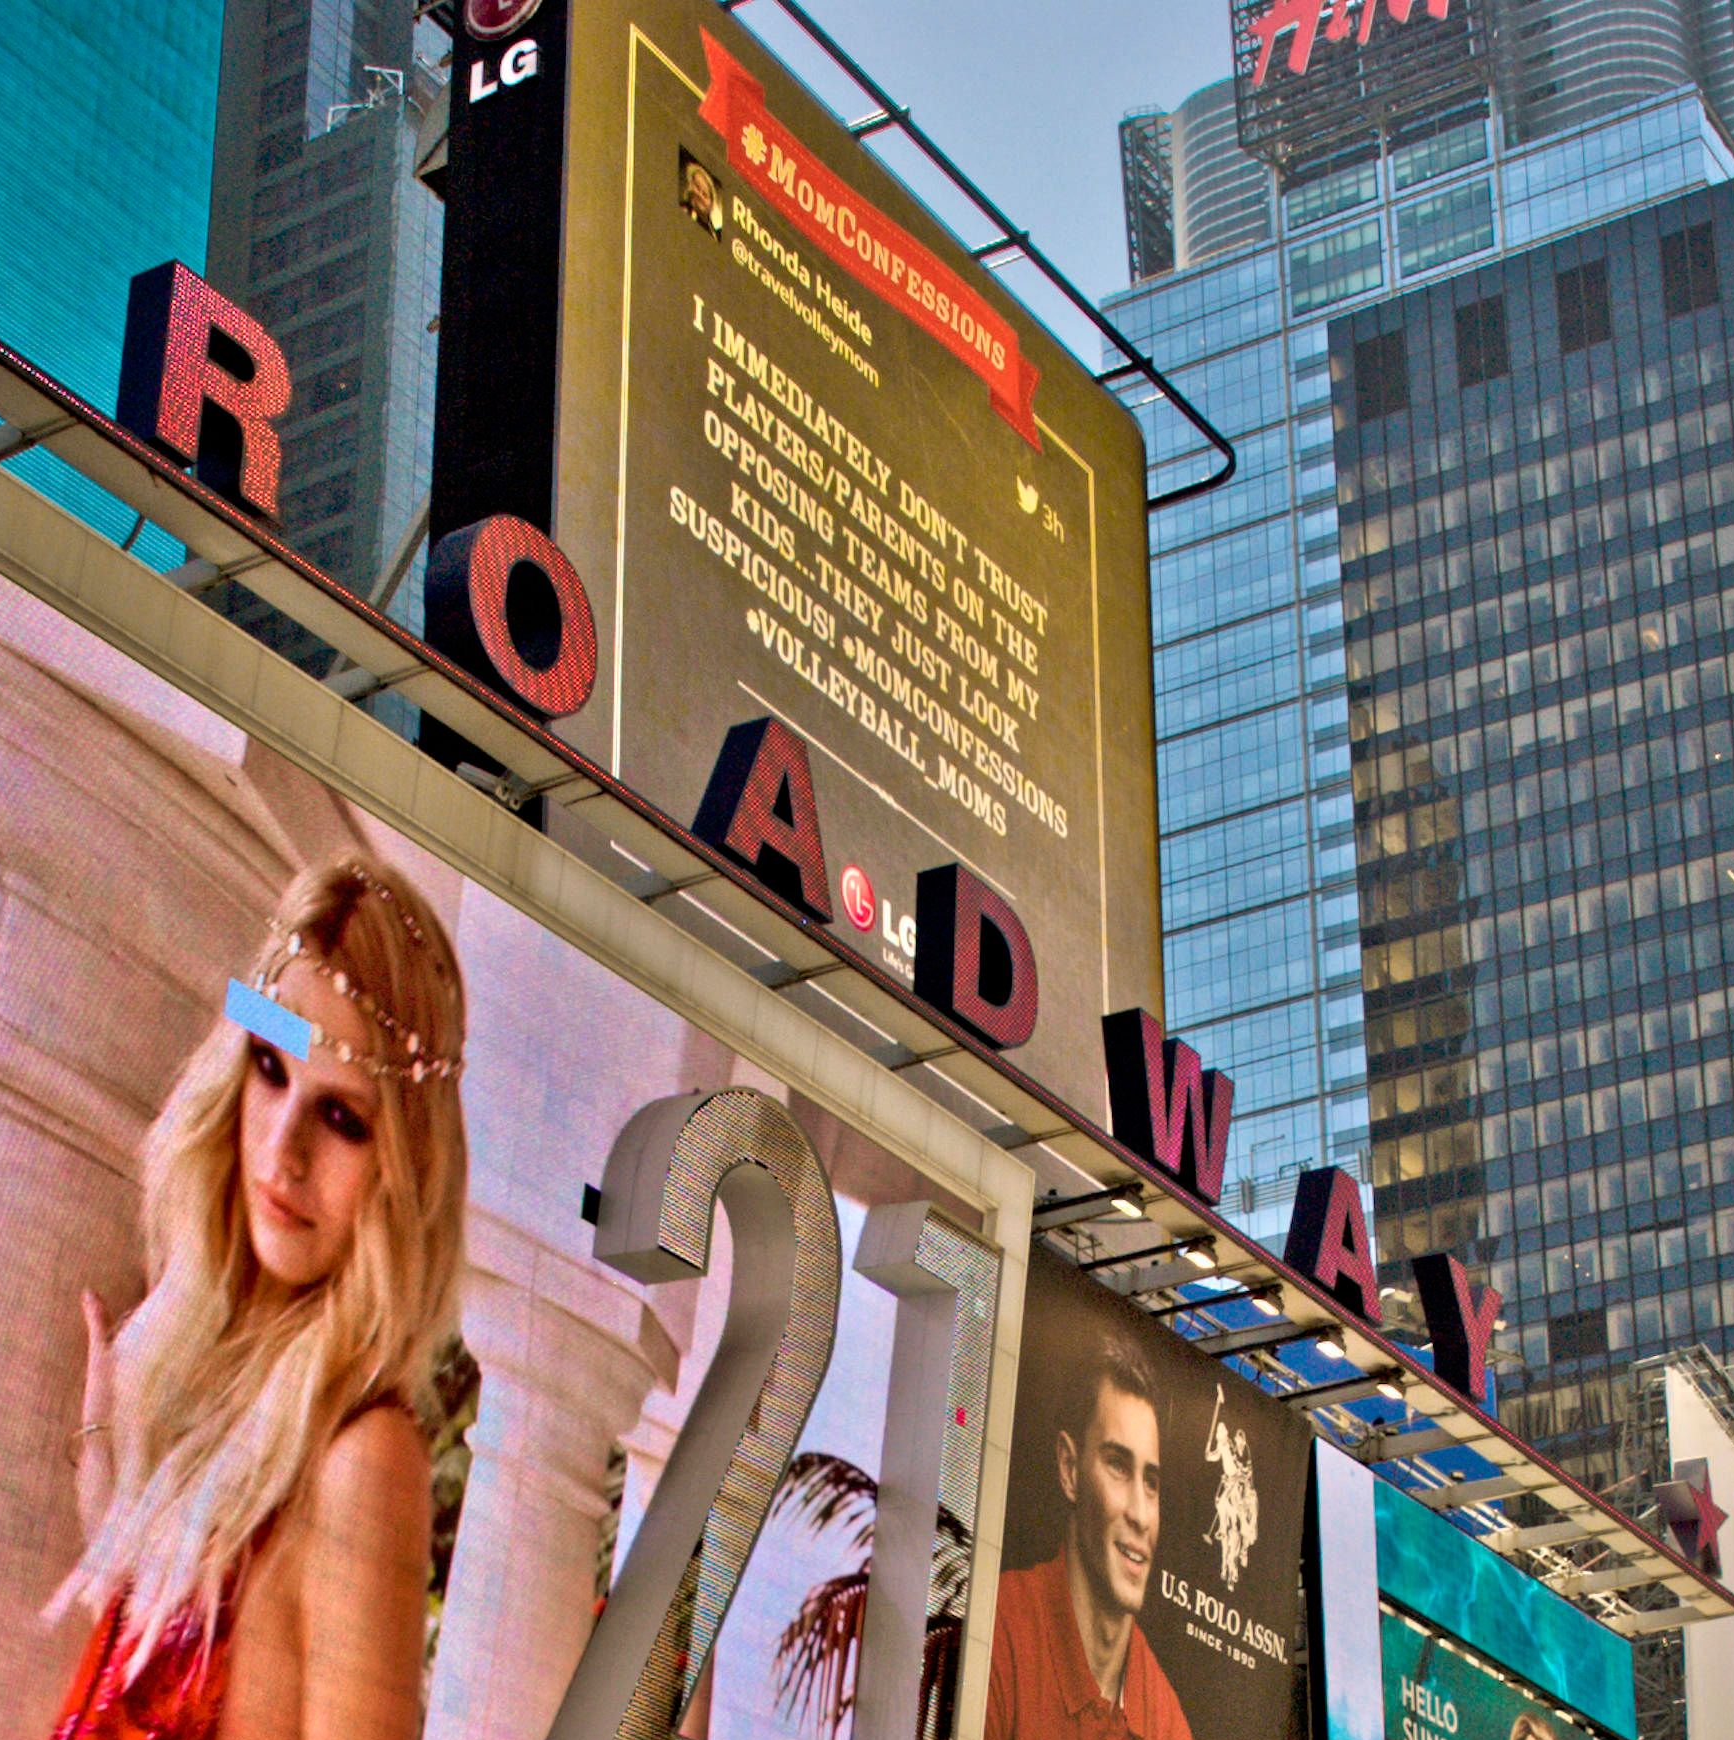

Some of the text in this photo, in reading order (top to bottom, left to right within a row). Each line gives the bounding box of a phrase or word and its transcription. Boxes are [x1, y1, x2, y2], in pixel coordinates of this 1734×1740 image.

[470, 38, 537, 104] LG
[731, 237, 880, 388] @travelvolleymom
[732, 195, 872, 346] Rhonda Heide
[693, 294, 1048, 637] I IMMEDIATELY DON'T TRUST
[707, 357, 1039, 675] PLAYERS/PARENTS ON THE
[1042, 504, 1065, 544] 3h
[704, 409, 1039, 721] OPPOSING TEAMS FROM MY
[669, 485, 1068, 838] SUSPICIOUS! #MOMCONFESSIONS
[746, 607, 1007, 836] #VOLLEYBALL_MOMS
[891, 620, 952, 693] JUST
[959, 676, 1020, 753] LOOK
[882, 899, 917, 957] LG
[1161, 1569, 1288, 1665] U.S. POLO ASSN.
[1187, 1622, 1256, 1670] SINCE 1890
[1401, 1675, 1457, 1734] HELLO
